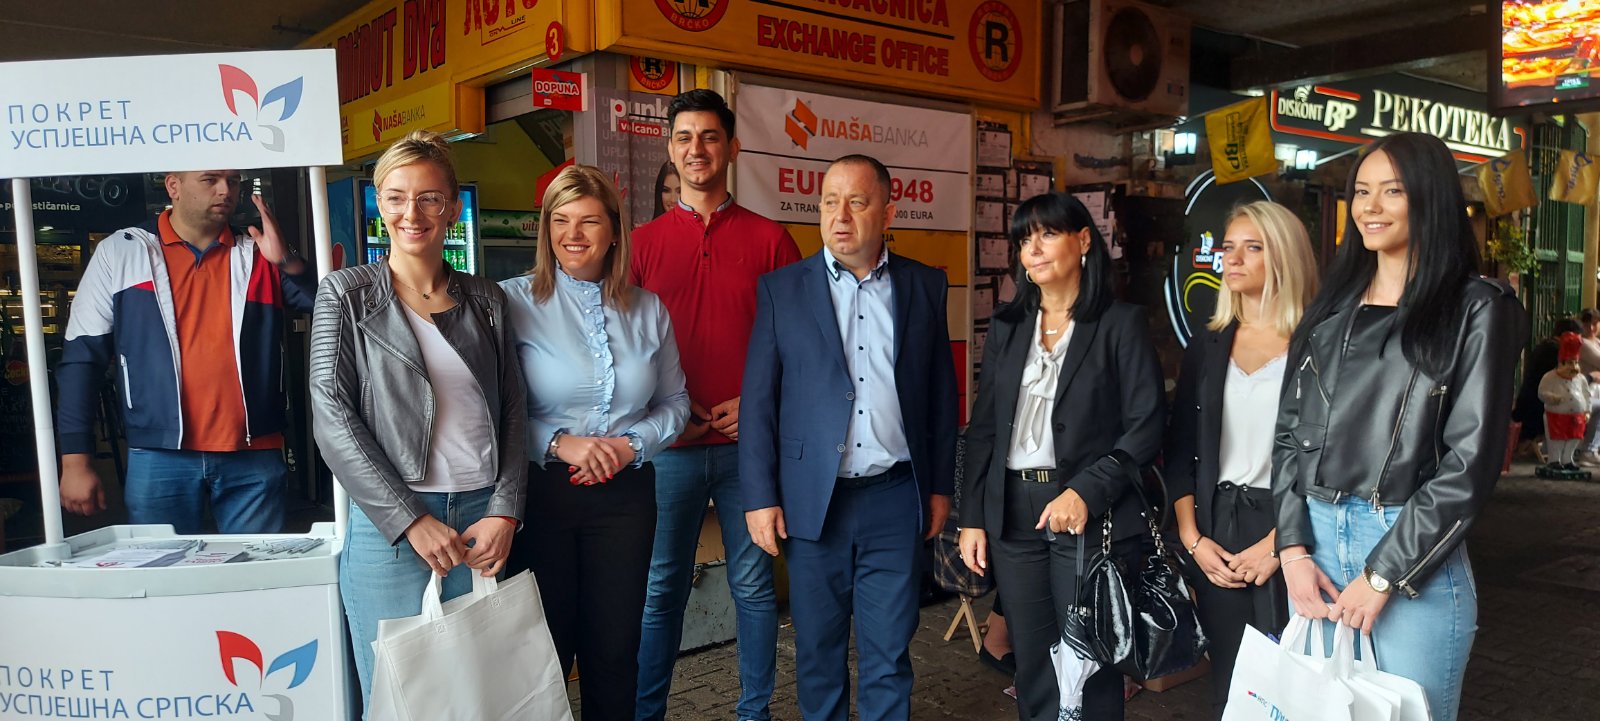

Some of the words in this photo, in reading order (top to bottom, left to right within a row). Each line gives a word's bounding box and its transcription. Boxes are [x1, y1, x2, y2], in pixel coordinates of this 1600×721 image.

[511, 15, 526, 25] LINE
[670, 13, 709, 29] BRČKO
[549, 28, 559, 56] 3
[757, 15, 876, 64] EXCHANGE
[881, 38, 949, 76] OFFICE
[985, 21, 1009, 62] R
[535, 80, 579, 96] DOPUNA
[9, 100, 132, 124] ПОКРЕТ
[383, 104, 426, 130] NAŠABANKA
[1278, 98, 1323, 121] DISKONT
[1324, 100, 1357, 132] BP
[1371, 90, 1511, 151] PEKOTEKA
[11, 125, 146, 149] УСПЈЕШНА
[152, 122, 254, 144] СРПСКА
[621, 122, 660, 135] volcano
[820, 116, 929, 148] NAŠABANKA
[780, 201, 792, 211] ZA
[794, 203, 820, 214] TRAN
[911, 211, 934, 220] EURA
[0, 693, 129, 718] УСПЈЕШНА
[137, 692, 255, 718] СРПСКА
